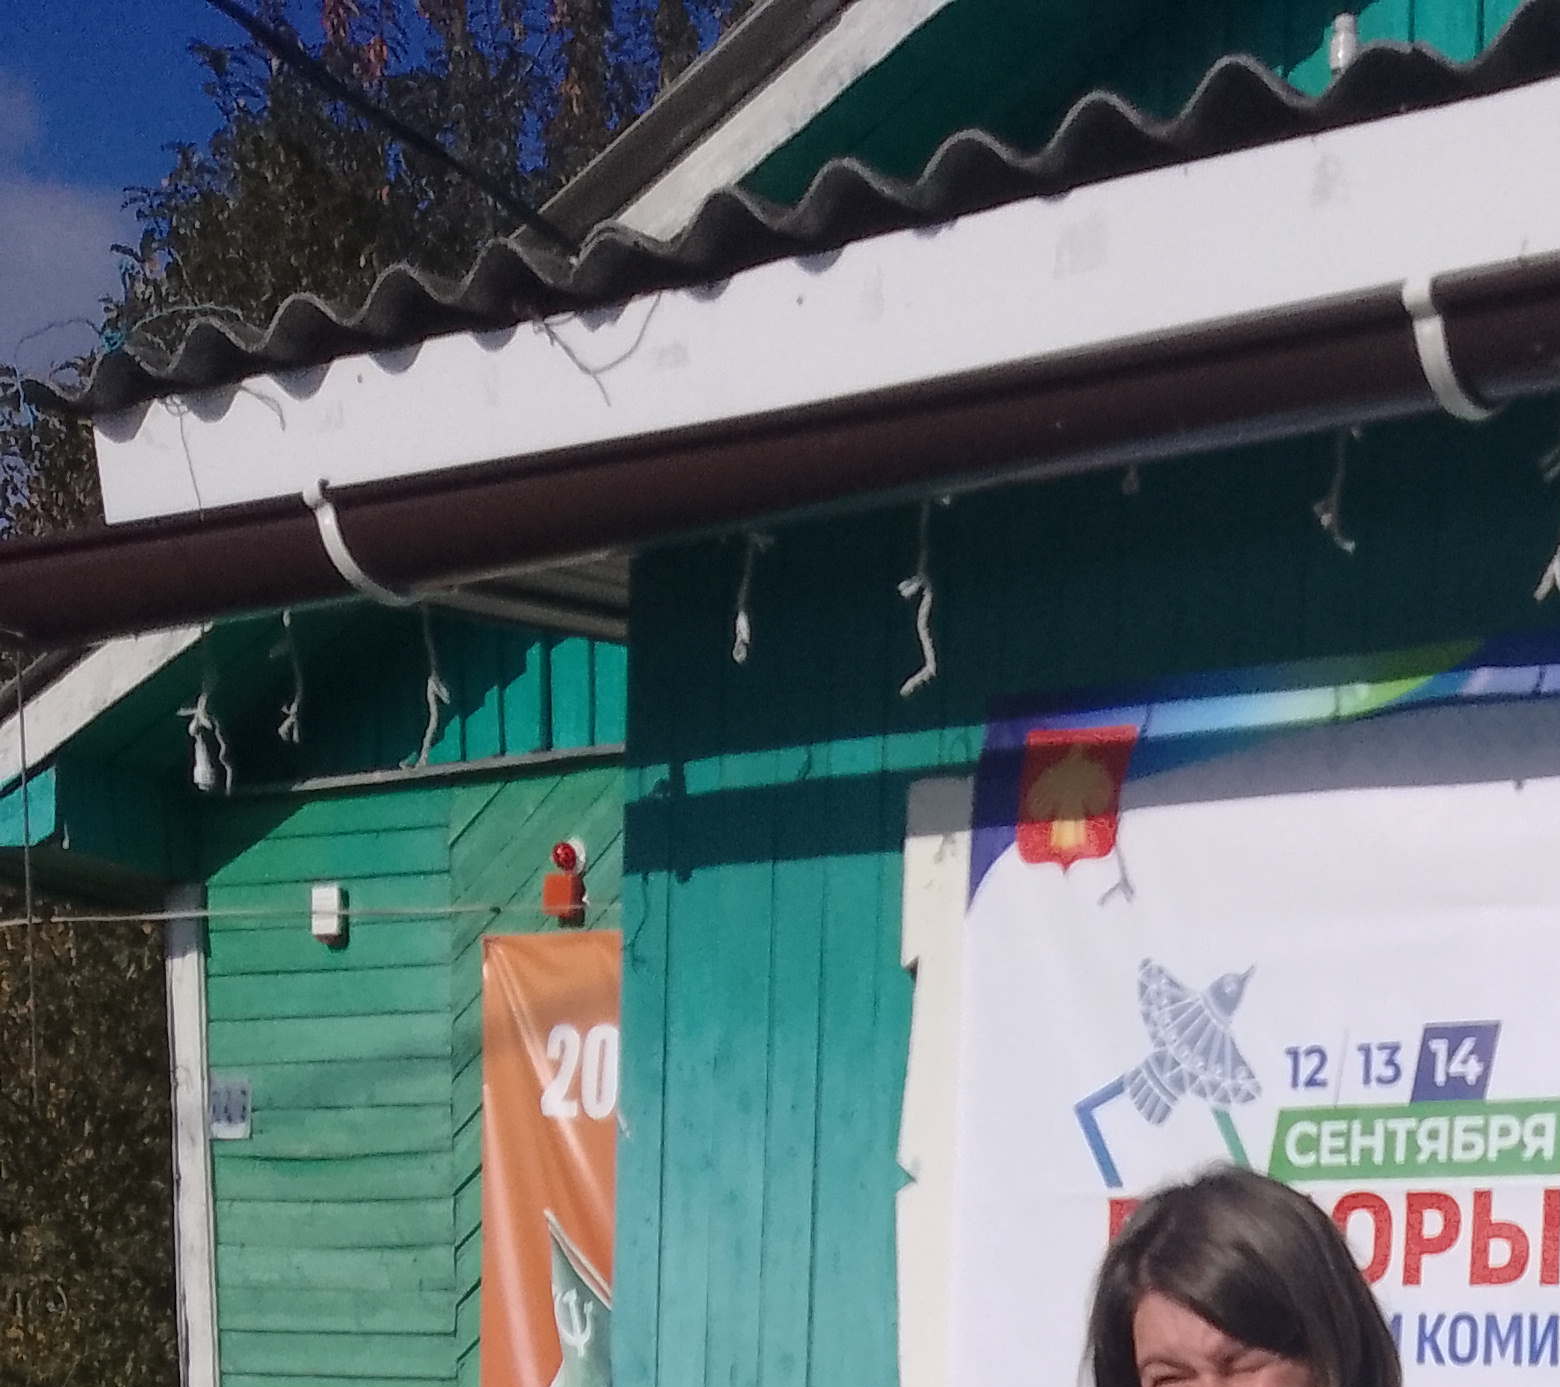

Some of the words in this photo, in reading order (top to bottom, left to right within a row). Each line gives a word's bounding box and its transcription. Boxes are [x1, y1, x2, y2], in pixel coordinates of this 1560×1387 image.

[539, 1023, 619, 1119] 20
[1284, 1045, 1329, 1089] 12
[1357, 1041, 1402, 1086] 13
[1427, 1036, 1484, 1087] 14
[1285, 1112, 1557, 1168] СЕНТЯБРЯ
[1416, 1312, 1560, 1367] КОМИ
